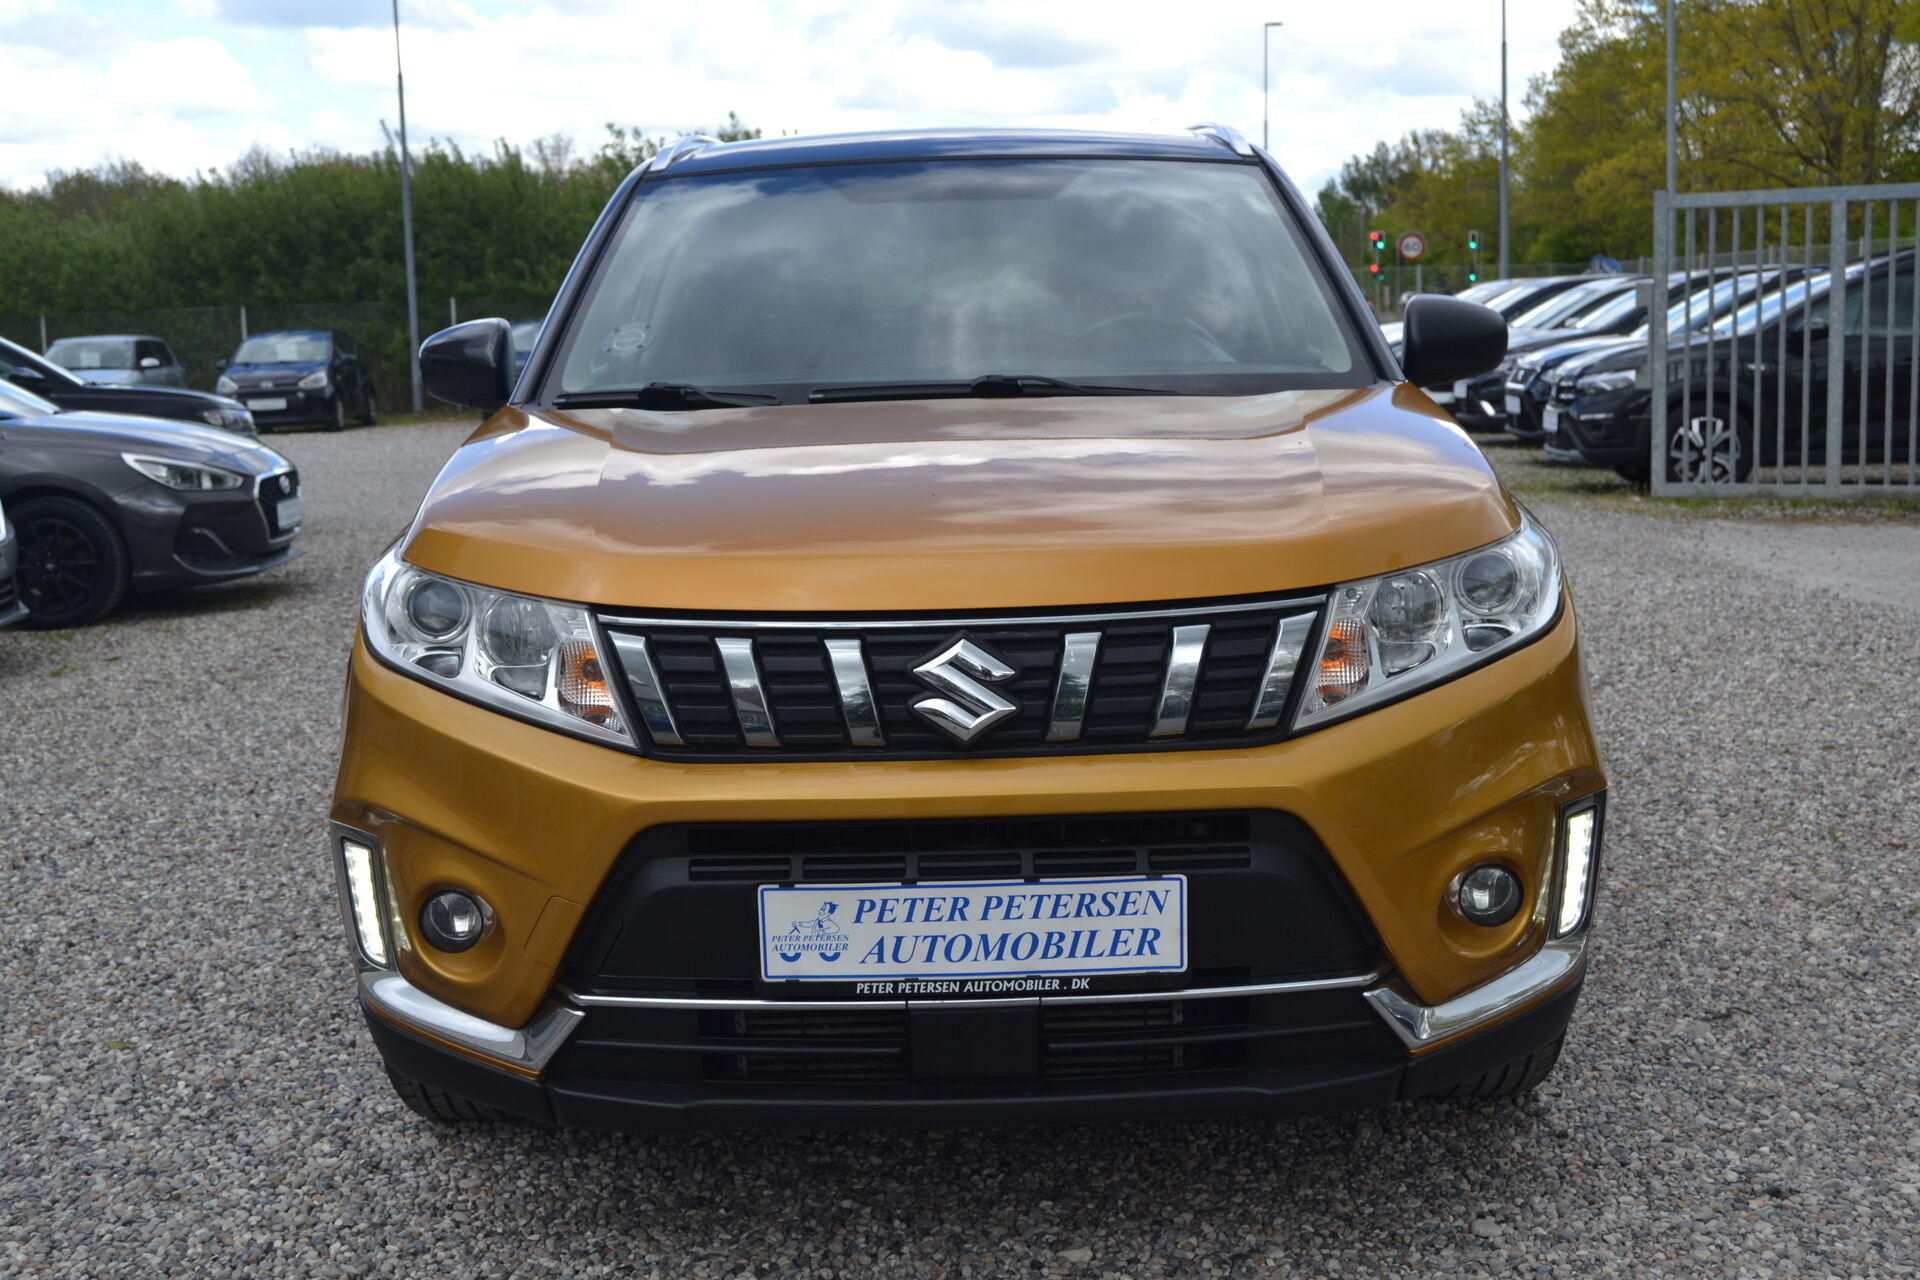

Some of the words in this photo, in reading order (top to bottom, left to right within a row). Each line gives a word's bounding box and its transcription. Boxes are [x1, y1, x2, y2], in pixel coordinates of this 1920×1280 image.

[851, 896, 971, 924] PETER
[978, 889, 1172, 921] PETERSEN
[803, 934, 850, 942] PETERSEN
[858, 927, 1162, 965] AUTOMOBILER
[771, 943, 849, 952] AUTOMOBILER
[856, 982, 894, 994] PETER
[898, 981, 960, 994] PETERSEN
[963, 978, 1060, 993] AUTOMOBILER
[1071, 978, 1091, 990] DK
